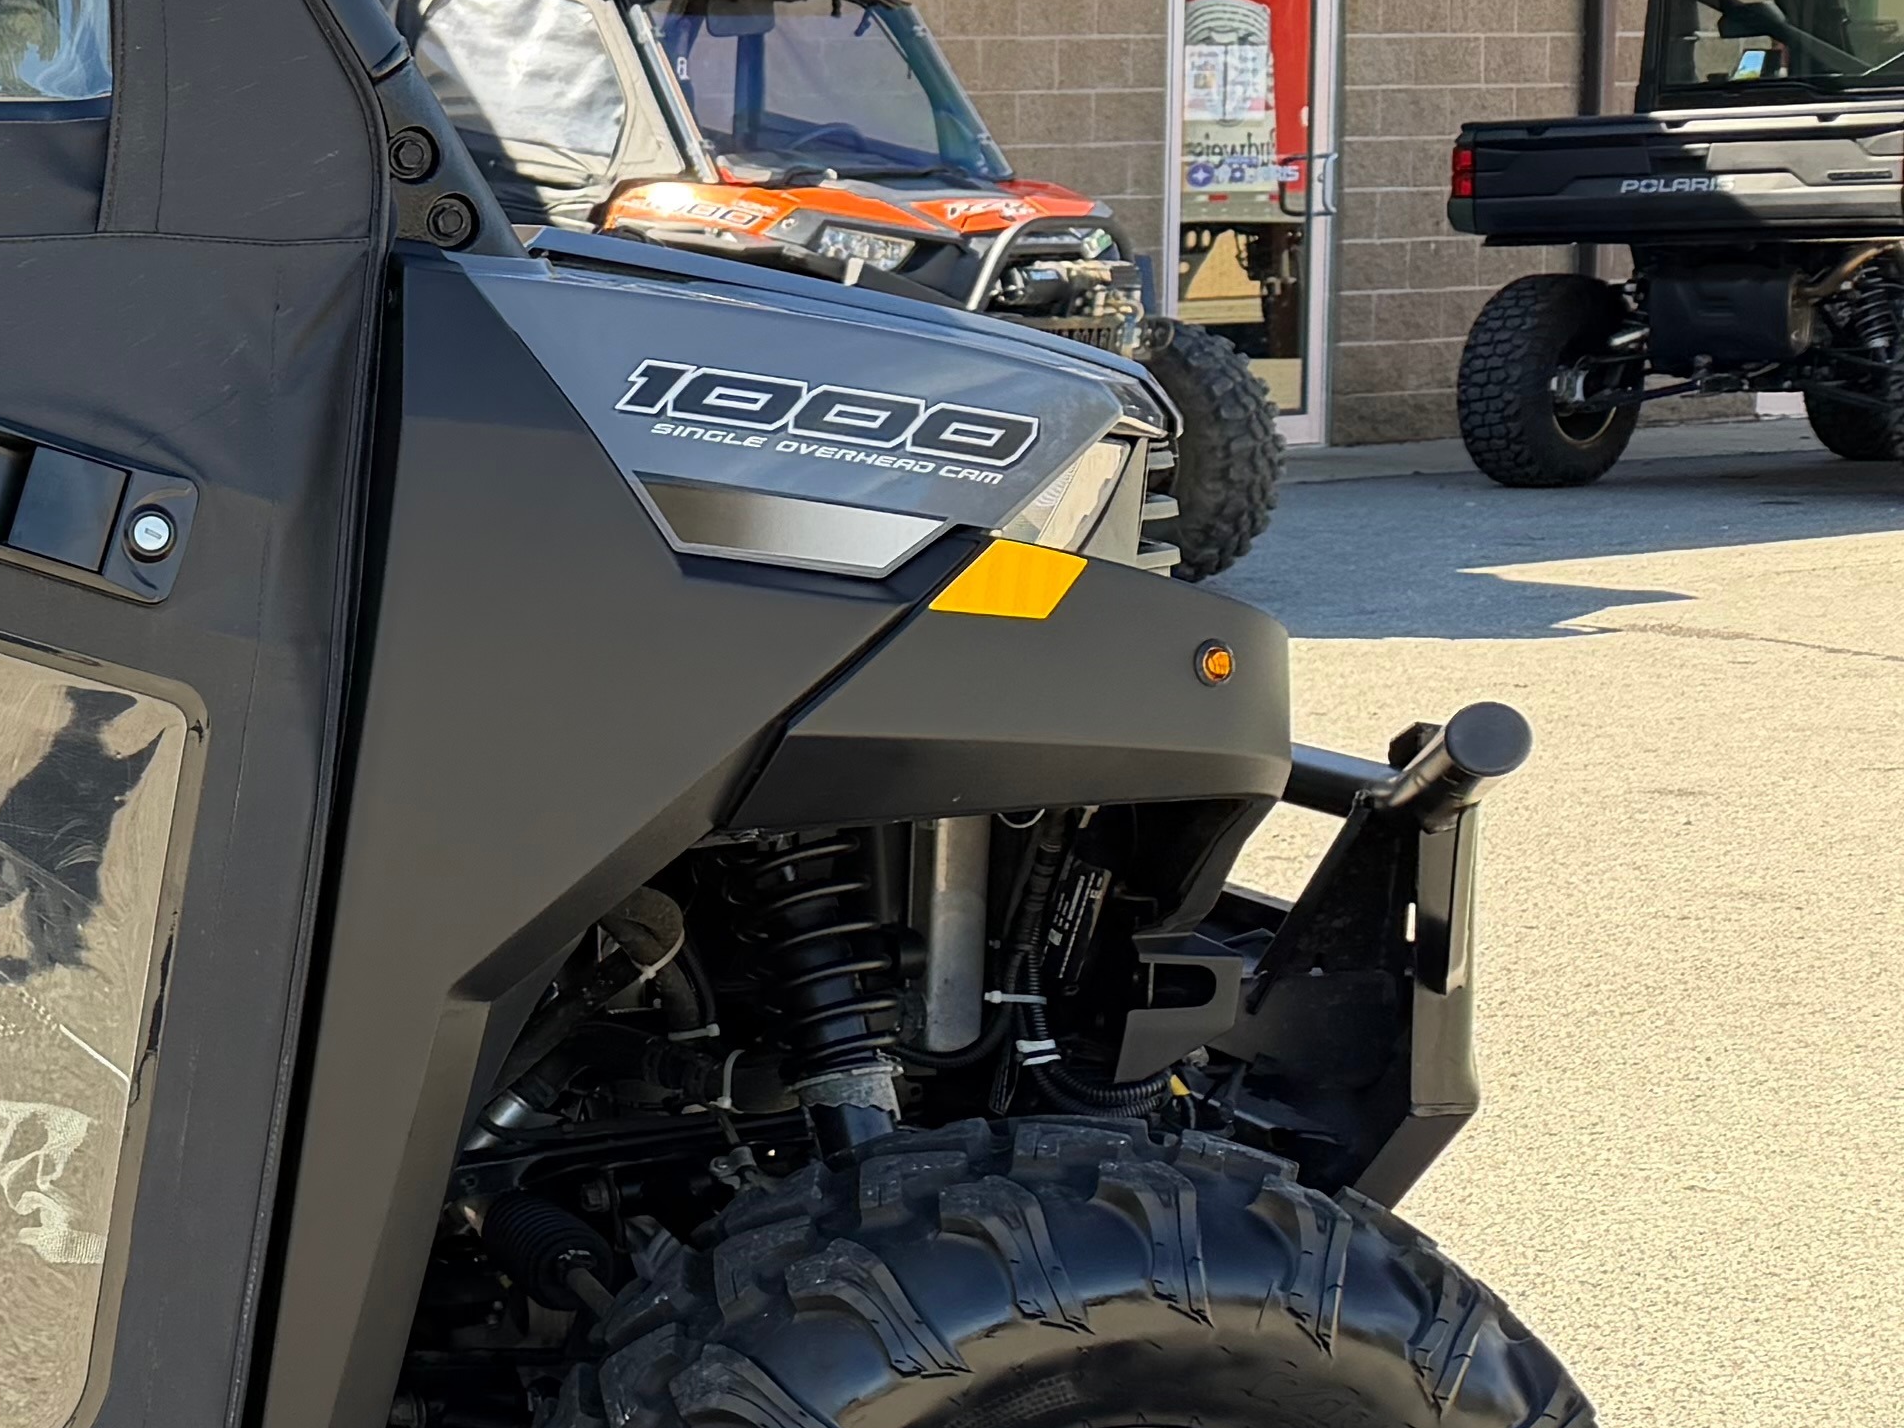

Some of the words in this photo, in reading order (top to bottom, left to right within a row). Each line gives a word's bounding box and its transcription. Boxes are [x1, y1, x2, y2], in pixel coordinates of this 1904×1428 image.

[1620, 176, 1736, 194] POLARIS
[614, 358, 1041, 468] 1000
[651, 423, 768, 449] SINGLE
[775, 439, 937, 474] OVERHEAD
[938, 465, 1004, 486] CAM
